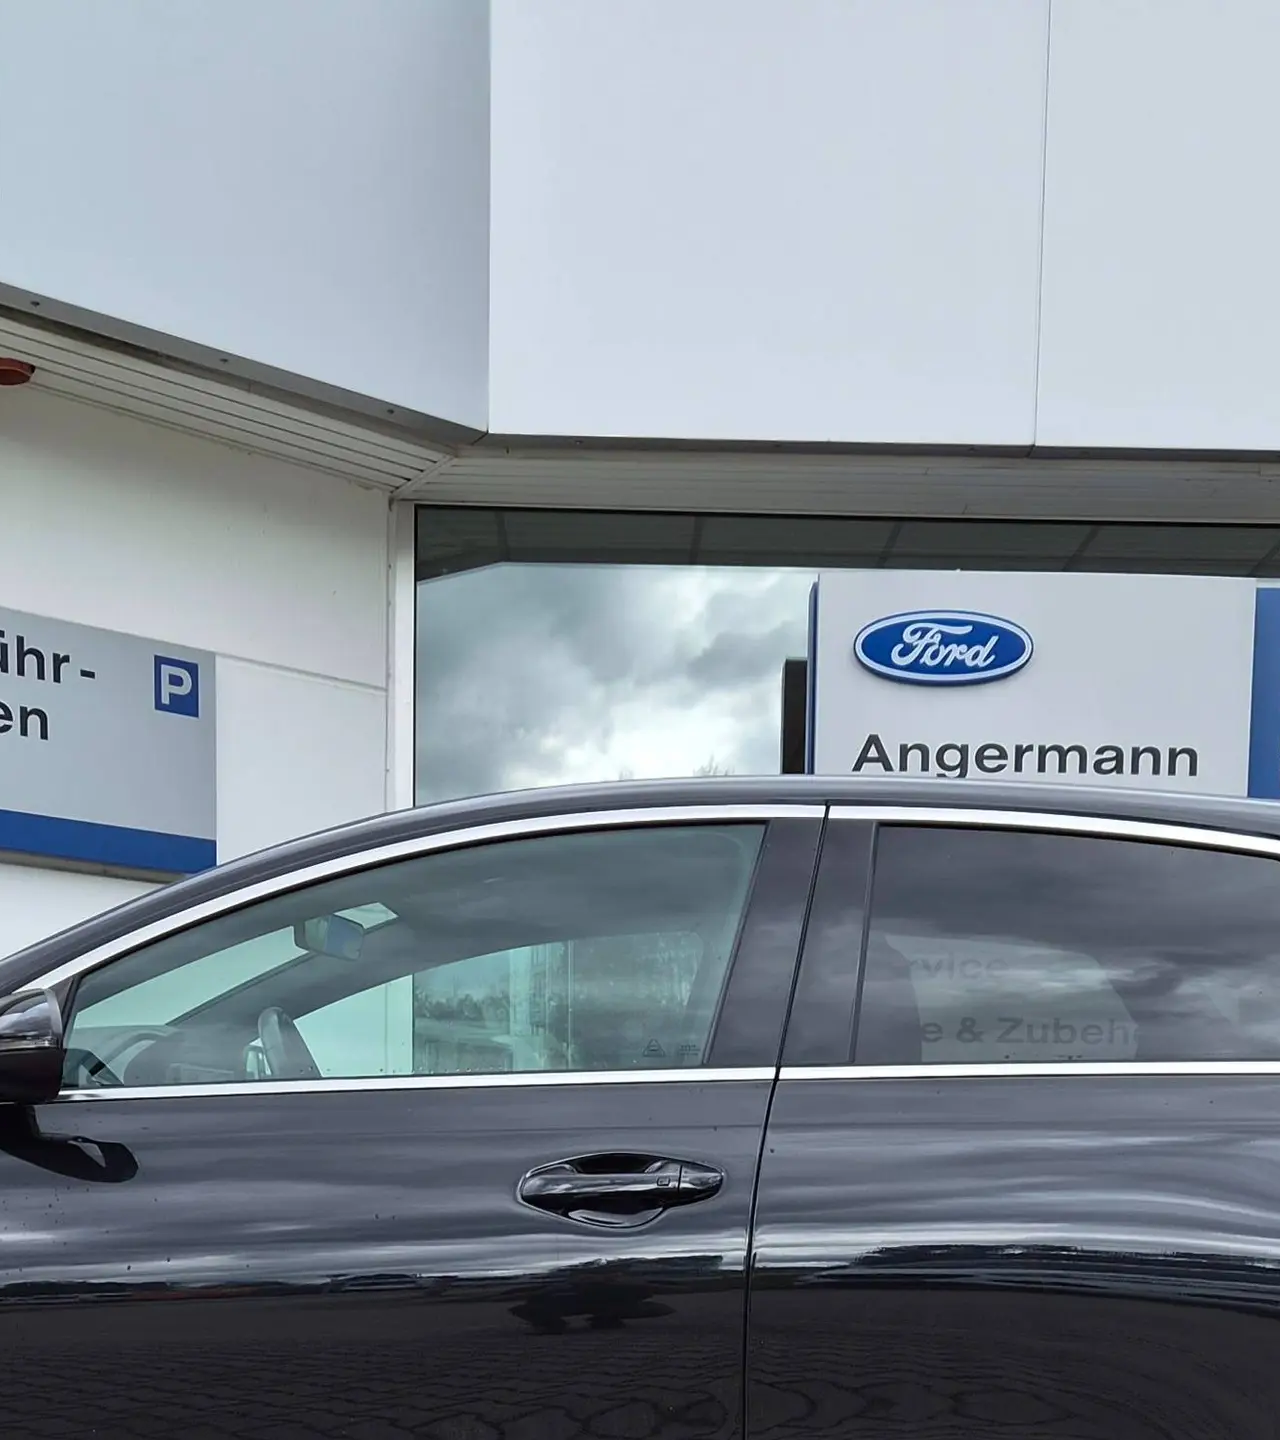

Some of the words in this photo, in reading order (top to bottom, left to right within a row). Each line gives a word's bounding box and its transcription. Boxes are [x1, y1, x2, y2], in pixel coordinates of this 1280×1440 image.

[890, 622, 1000, 668] Ford
[160, 664, 193, 707] P
[851, 733, 1199, 778] Angermann
